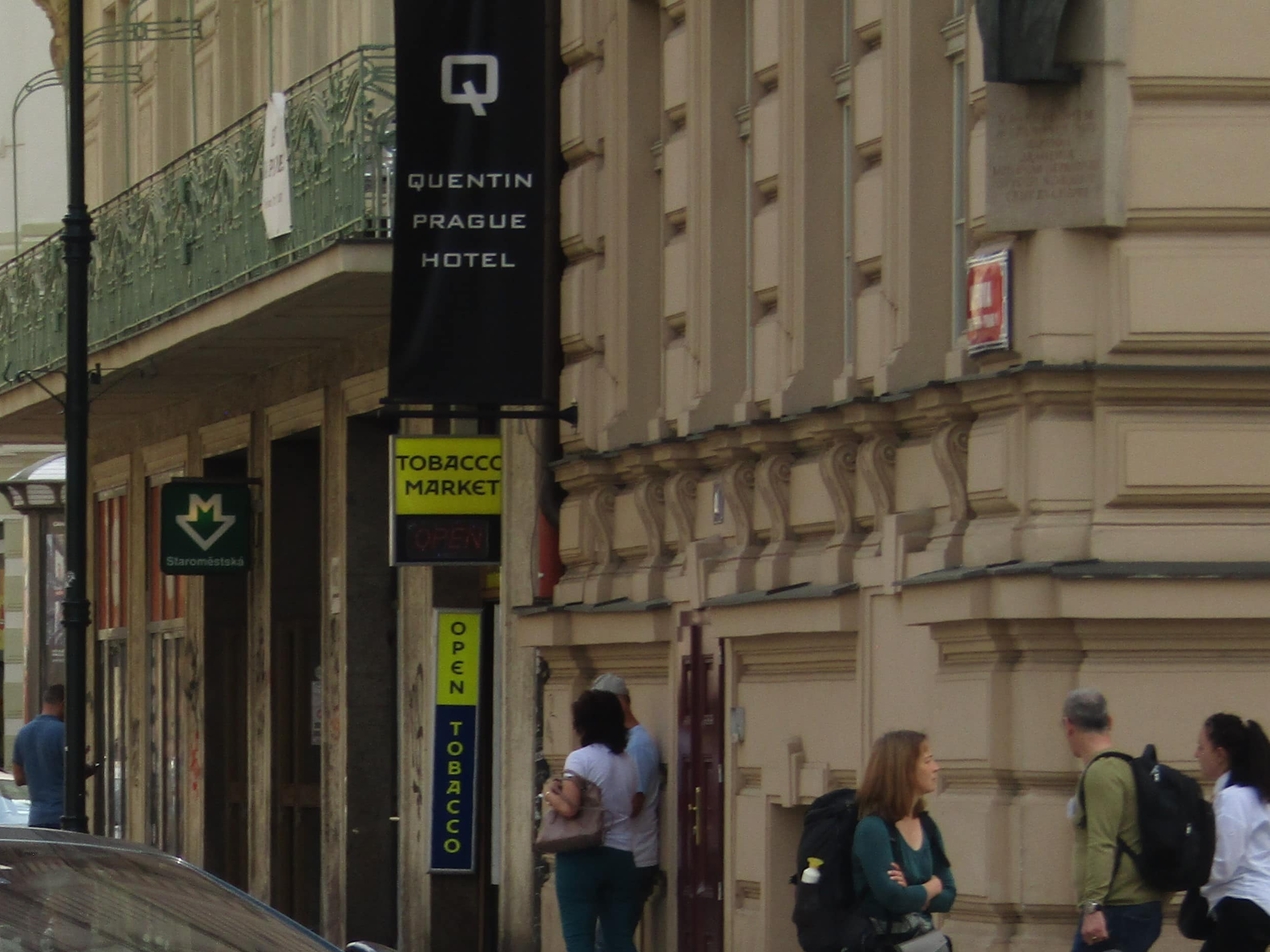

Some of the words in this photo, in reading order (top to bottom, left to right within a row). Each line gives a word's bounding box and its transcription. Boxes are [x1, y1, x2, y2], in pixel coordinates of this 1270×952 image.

[441, 55, 499, 116] Q
[408, 173, 533, 192] QUENTIN
[413, 214, 527, 229] PRAGUE
[422, 253, 516, 268] HOTEL
[396, 455, 502, 471] TOBACCO
[405, 480, 500, 495] MARKET
[415, 526, 482, 551] OPEN
[166, 556, 244, 567] Staroměstská
[449, 621, 467, 694] OPEN
[443, 721, 464, 854] TOBACCO
